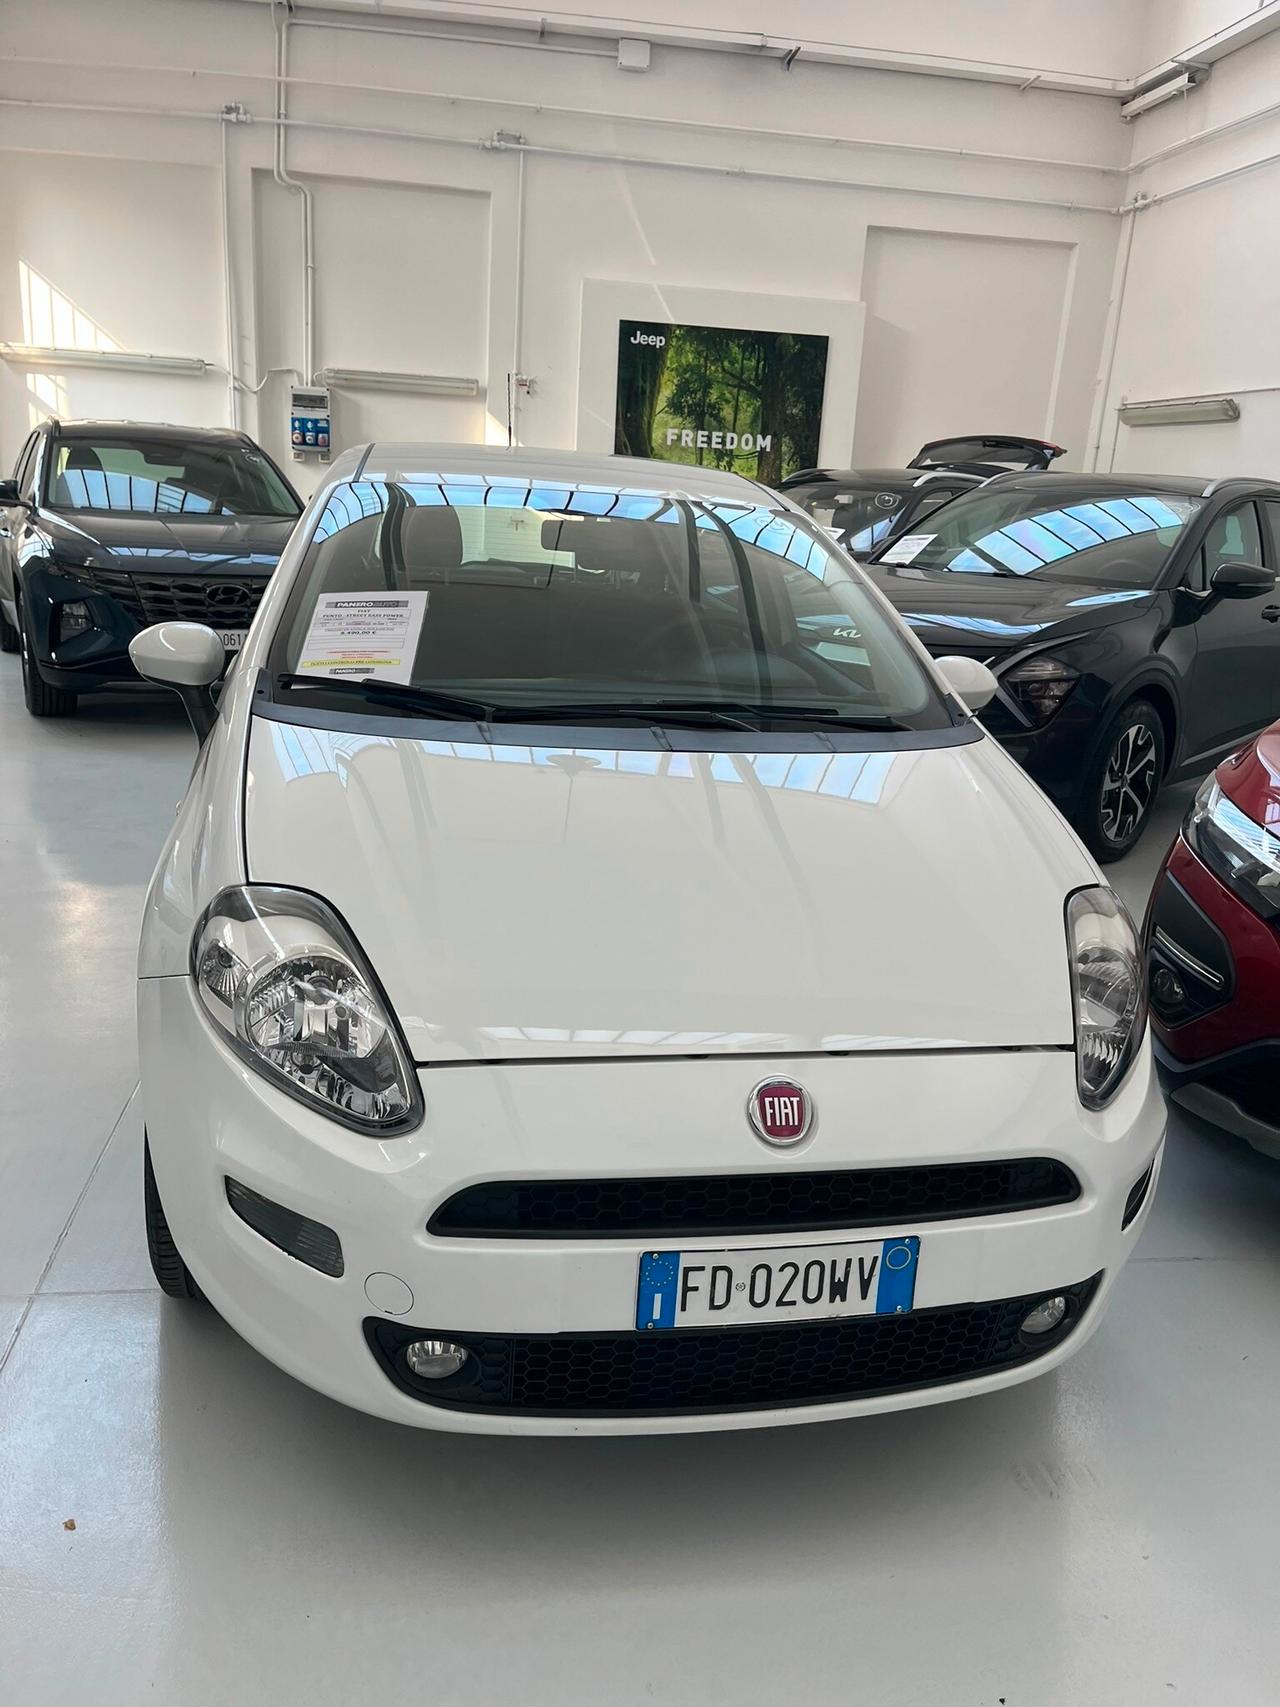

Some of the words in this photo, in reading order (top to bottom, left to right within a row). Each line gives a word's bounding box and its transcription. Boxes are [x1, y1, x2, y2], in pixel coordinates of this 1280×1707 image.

[630, 331, 666, 349] Jeep
[666, 428, 772, 452] FREEDOM
[764, 1097, 800, 1126] FIAT
